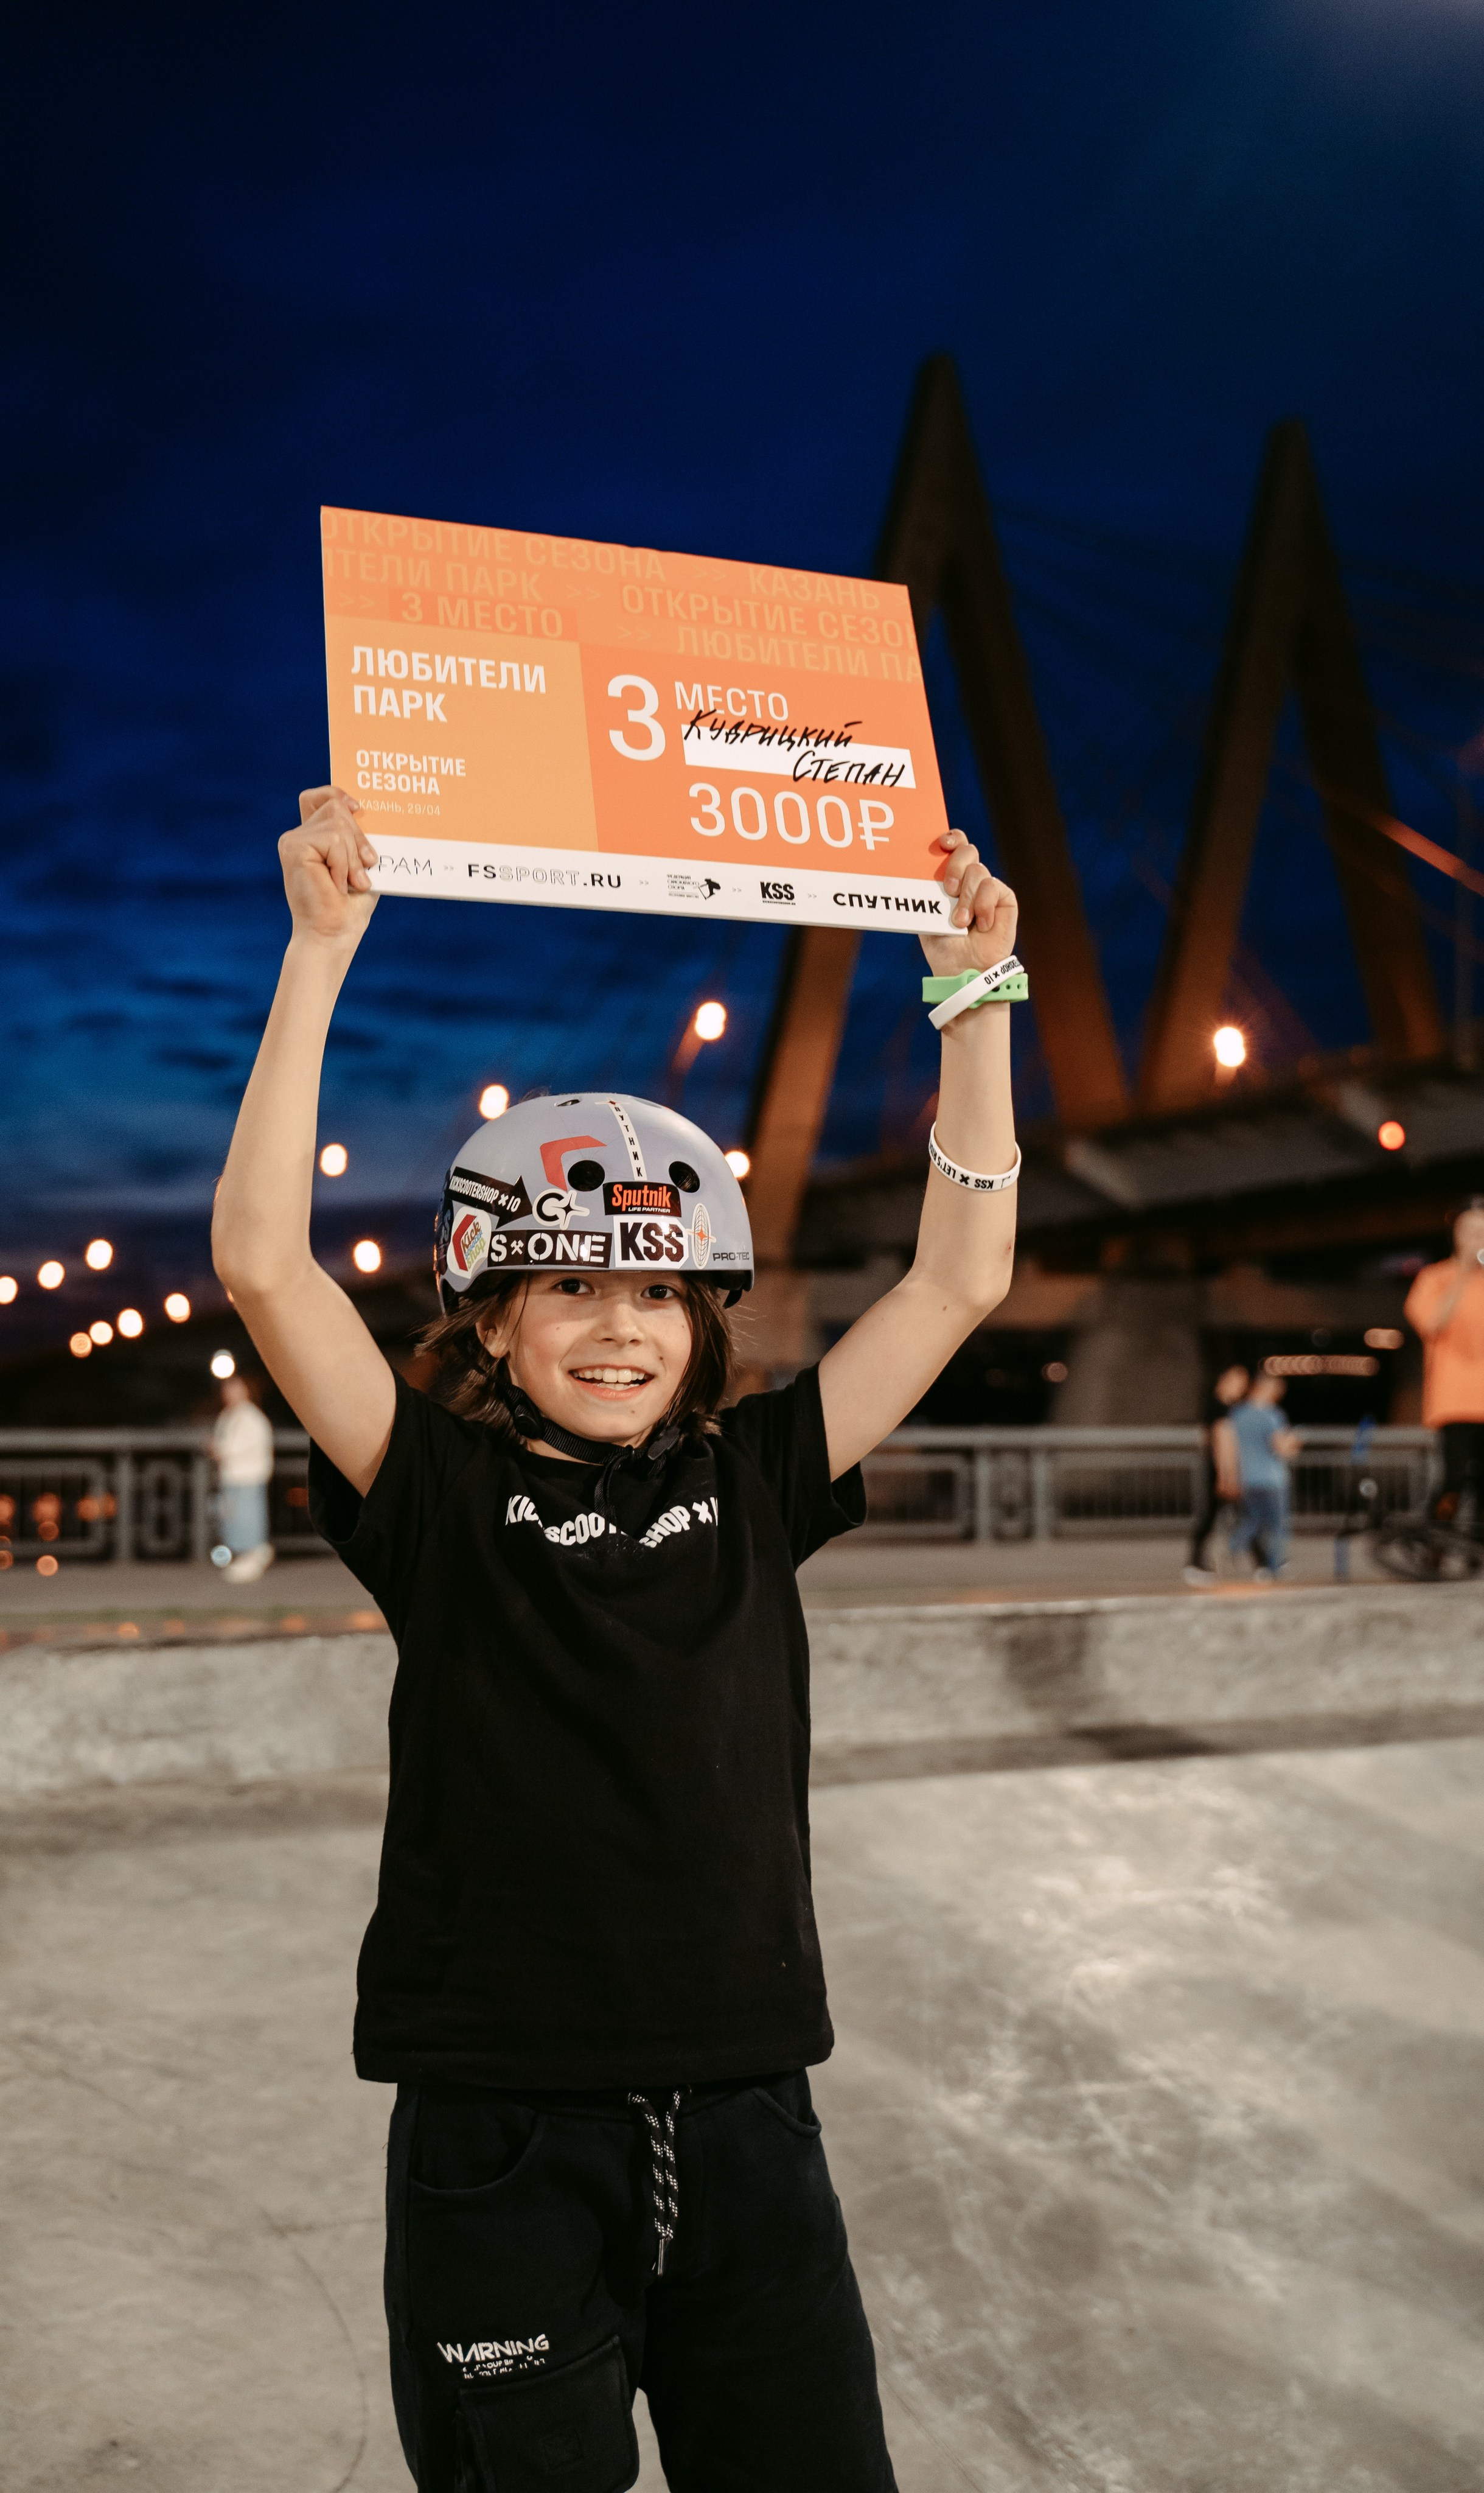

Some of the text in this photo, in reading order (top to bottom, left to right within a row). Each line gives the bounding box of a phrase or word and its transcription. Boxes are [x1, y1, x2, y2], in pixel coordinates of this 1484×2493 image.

[525, 537, 665, 581] СЕЗОНА
[748, 567, 880, 609] КАЗАНЬ
[446, 562, 542, 603] ПАРК
[622, 586, 806, 636] ОТКРЫТИЕ
[401, 592, 423, 623] 3
[437, 596, 563, 638] МЕСТО
[678, 626, 869, 677] ЛЮБИТЕЛИ
[352, 645, 546, 694] ЛЮБИТЕЛИ
[354, 685, 447, 722] ПАРК
[607, 674, 789, 761] 3 МЕСТО
[356, 749, 466, 777] ОТКРЫТИЕ
[357, 771, 440, 795] СЕЗОНА
[368, 855, 433, 876] РАМ
[468, 864, 622, 889] FSSPORT.RU
[760, 881, 795, 901] KSS
[833, 893, 942, 915] СПУТНИК
[937, 1156, 956, 1179] LET'S
[612, 1184, 671, 1211] Sputnik
[974, 1178, 994, 1189] KSS
[621, 1222, 685, 1261] KSS
[437, 2334, 549, 2364] WARNING
